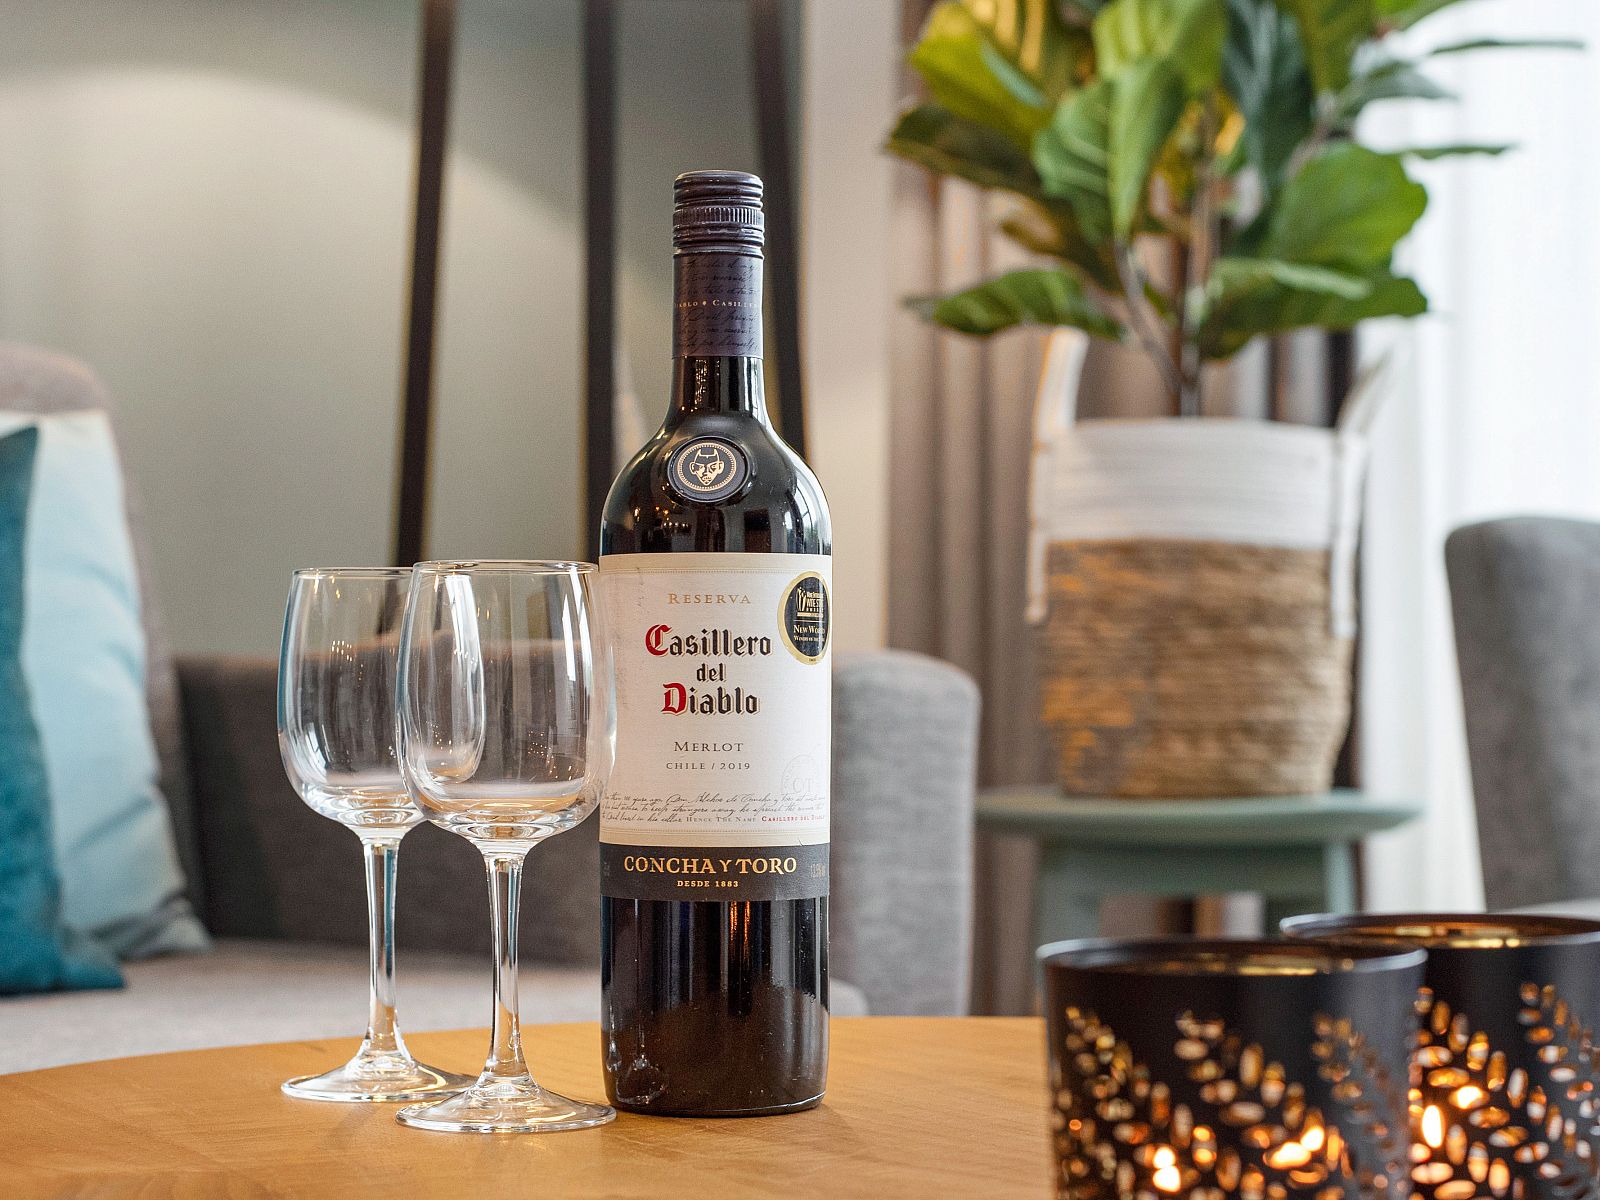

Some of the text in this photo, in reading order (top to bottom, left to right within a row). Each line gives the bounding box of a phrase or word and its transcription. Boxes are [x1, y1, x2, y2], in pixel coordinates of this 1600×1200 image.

[667, 593, 752, 605] RESERVA
[645, 624, 773, 657] Casillero
[696, 663, 727, 682] del
[661, 682, 761, 716] Diablo
[674, 741, 744, 752] MERLOT
[666, 762, 706, 770] CHILE
[720, 762, 751, 770] 2019
[624, 856, 716, 875] CONCHA
[720, 859, 734, 873] Y
[734, 857, 798, 875] TORO
[677, 880, 739, 888] DESDE 1883
